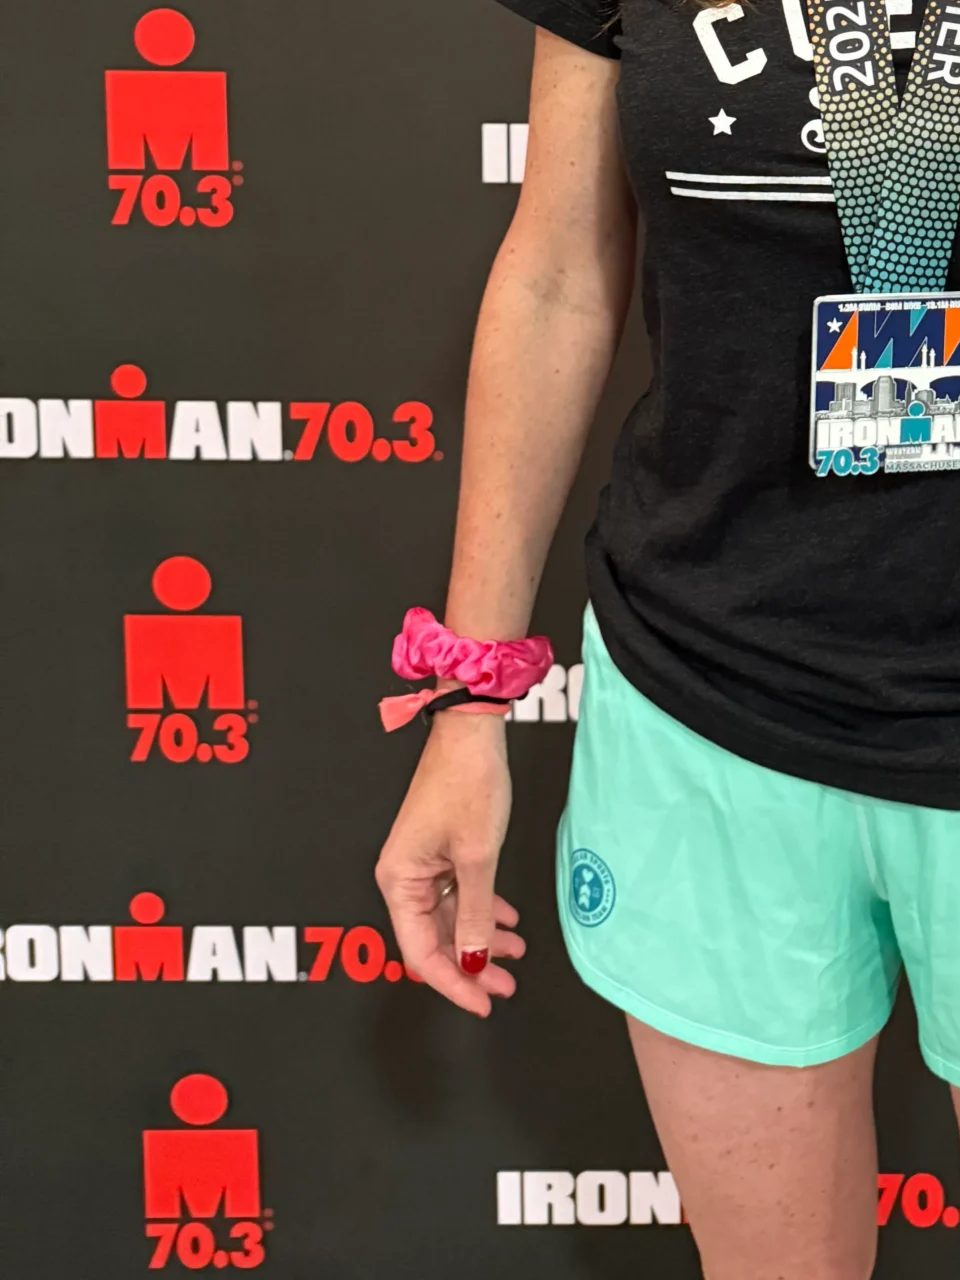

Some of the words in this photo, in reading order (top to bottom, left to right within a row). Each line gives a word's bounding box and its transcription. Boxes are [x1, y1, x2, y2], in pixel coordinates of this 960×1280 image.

[108, 174, 234, 228] 70.3
[290, 402, 435, 463] 70.3
[816, 446, 880, 477] 70.3
[127, 713, 249, 764] 70.3
[0, 925, 298, 982] ONMAN
[304, 926, 427, 984] 70.
[498, 1171, 690, 1225] IRON
[146, 1222, 265, 1269] 70.3
